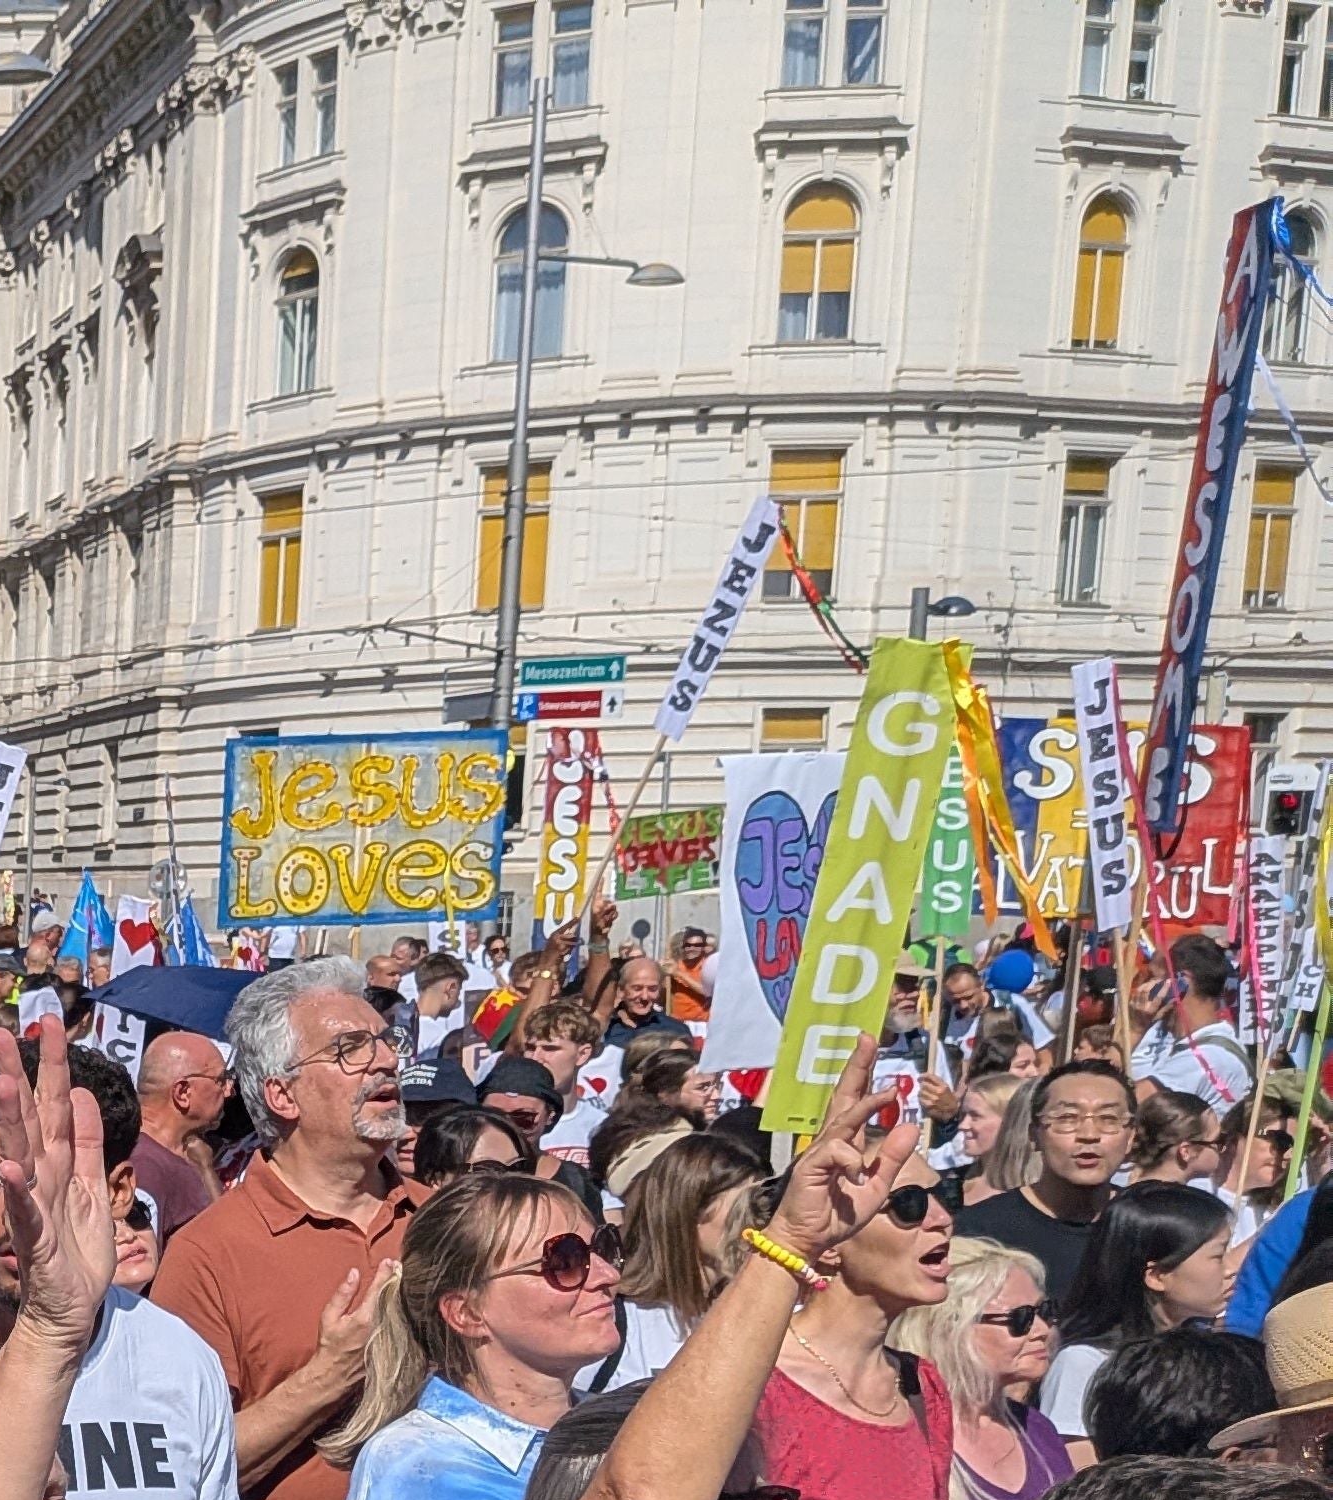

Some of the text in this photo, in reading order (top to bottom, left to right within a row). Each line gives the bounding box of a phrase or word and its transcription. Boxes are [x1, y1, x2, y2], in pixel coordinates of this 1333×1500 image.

[524, 663, 606, 680] Messezentrum
[669, 522, 775, 713] JEZUS
[543, 731, 586, 940] JESU
[795, 691, 941, 1085] GNADE
[1084, 679, 1129, 896] JESUS
